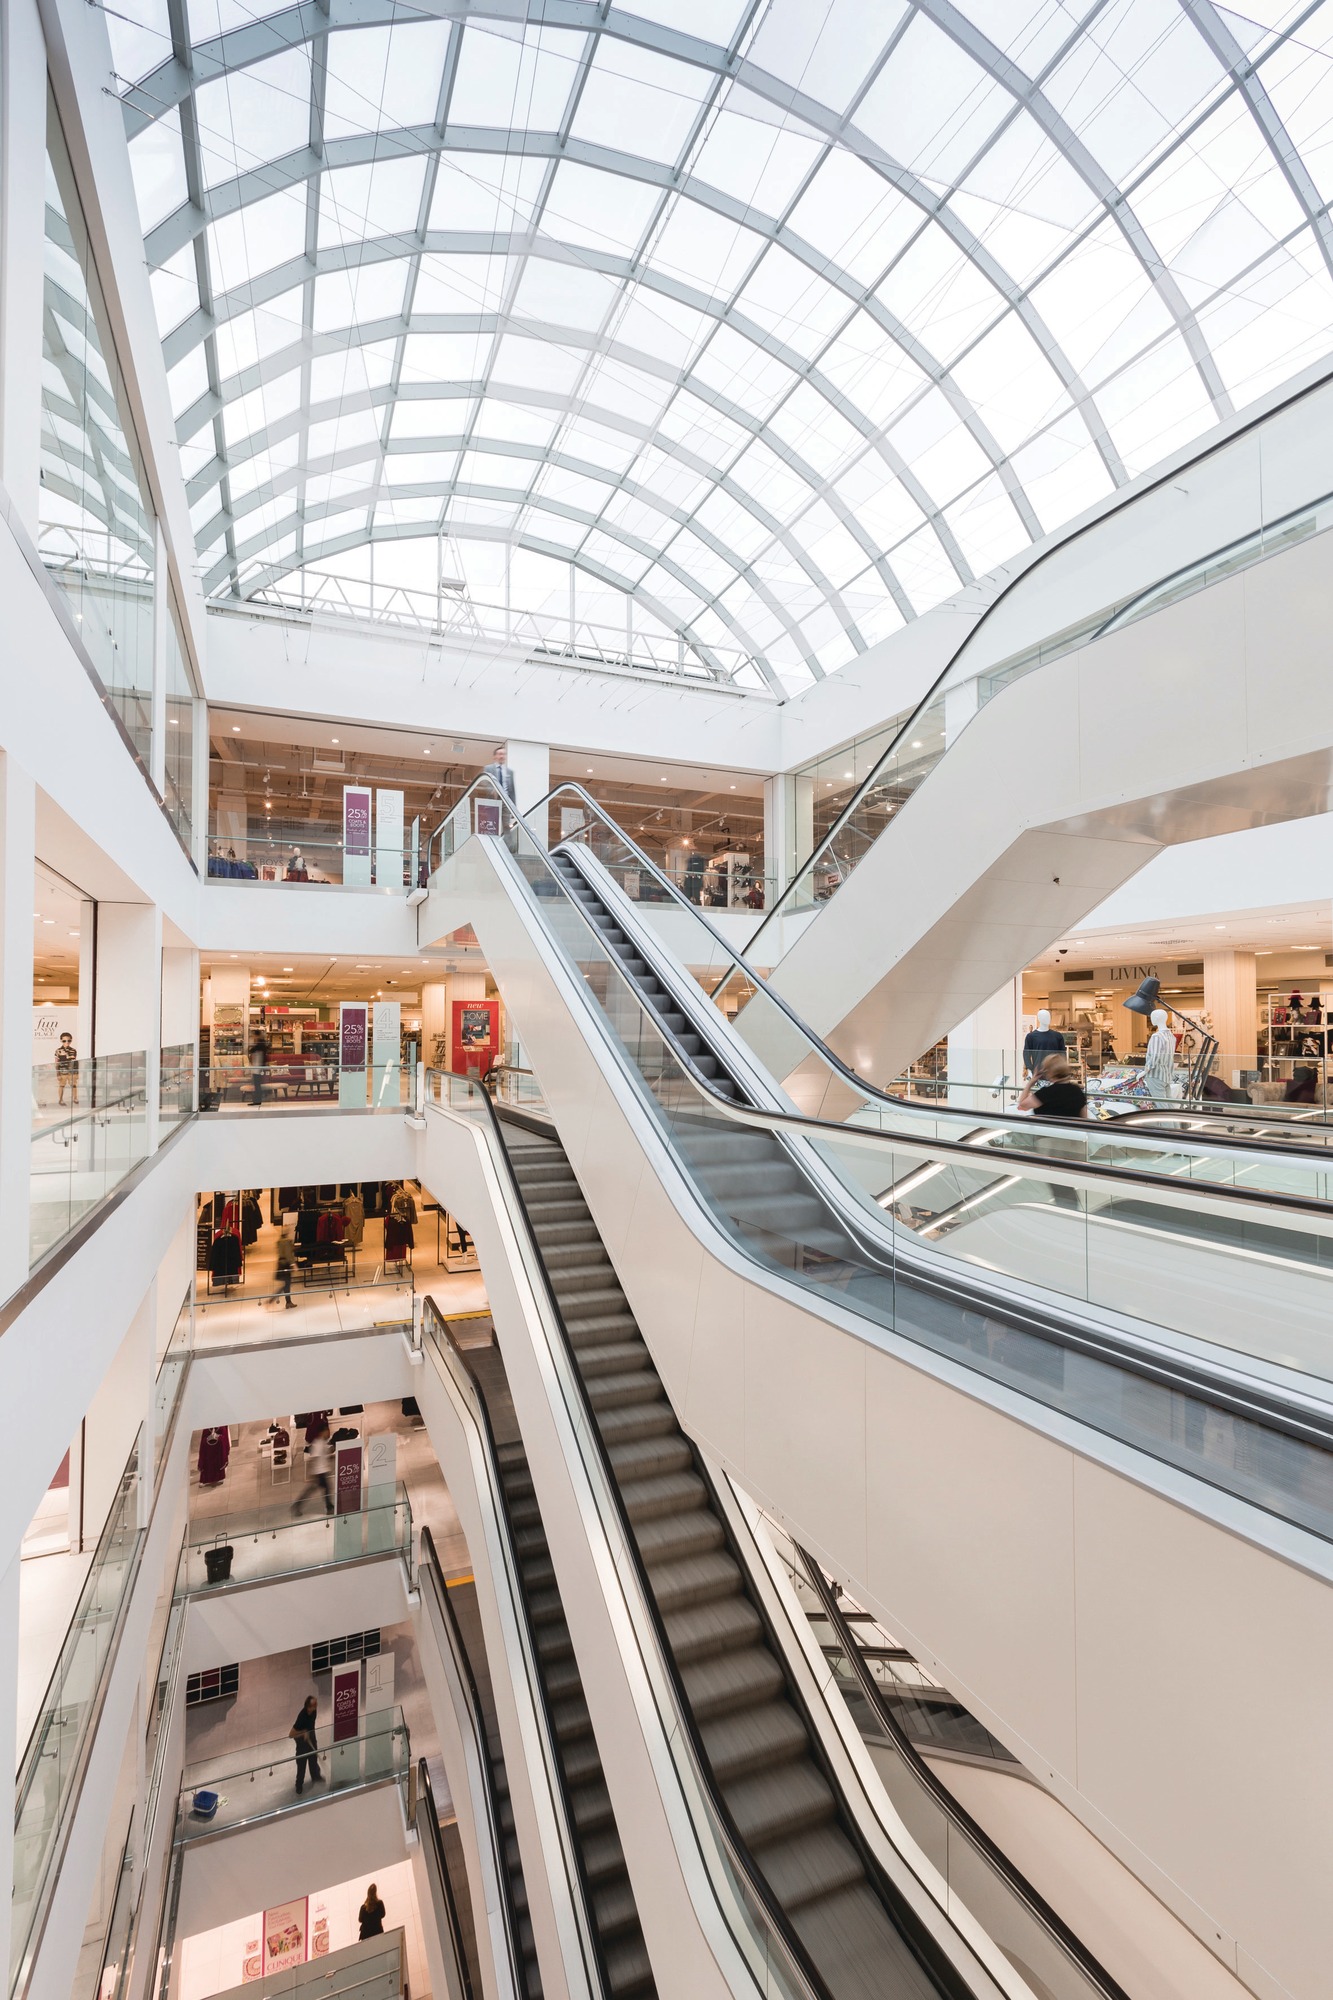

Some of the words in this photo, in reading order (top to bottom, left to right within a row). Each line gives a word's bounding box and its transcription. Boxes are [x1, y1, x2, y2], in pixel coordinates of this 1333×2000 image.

[381, 795, 395, 816] 5
[347, 808, 367, 819] 25%
[260, 858, 285, 867] BOYS
[1110, 966, 1158, 981] LIVING
[376, 1008, 393, 1029] 4
[464, 1011, 489, 1020] HOME
[34, 1017, 58, 1031] fun
[343, 1024, 364, 1035] 25%
[372, 1443, 386, 1465] 2
[339, 1464, 360, 1477] 25%
[370, 1664, 381, 1687] 1
[336, 1688, 357, 1702] 25%
[267, 1953, 303, 1971] CLINIQUE
